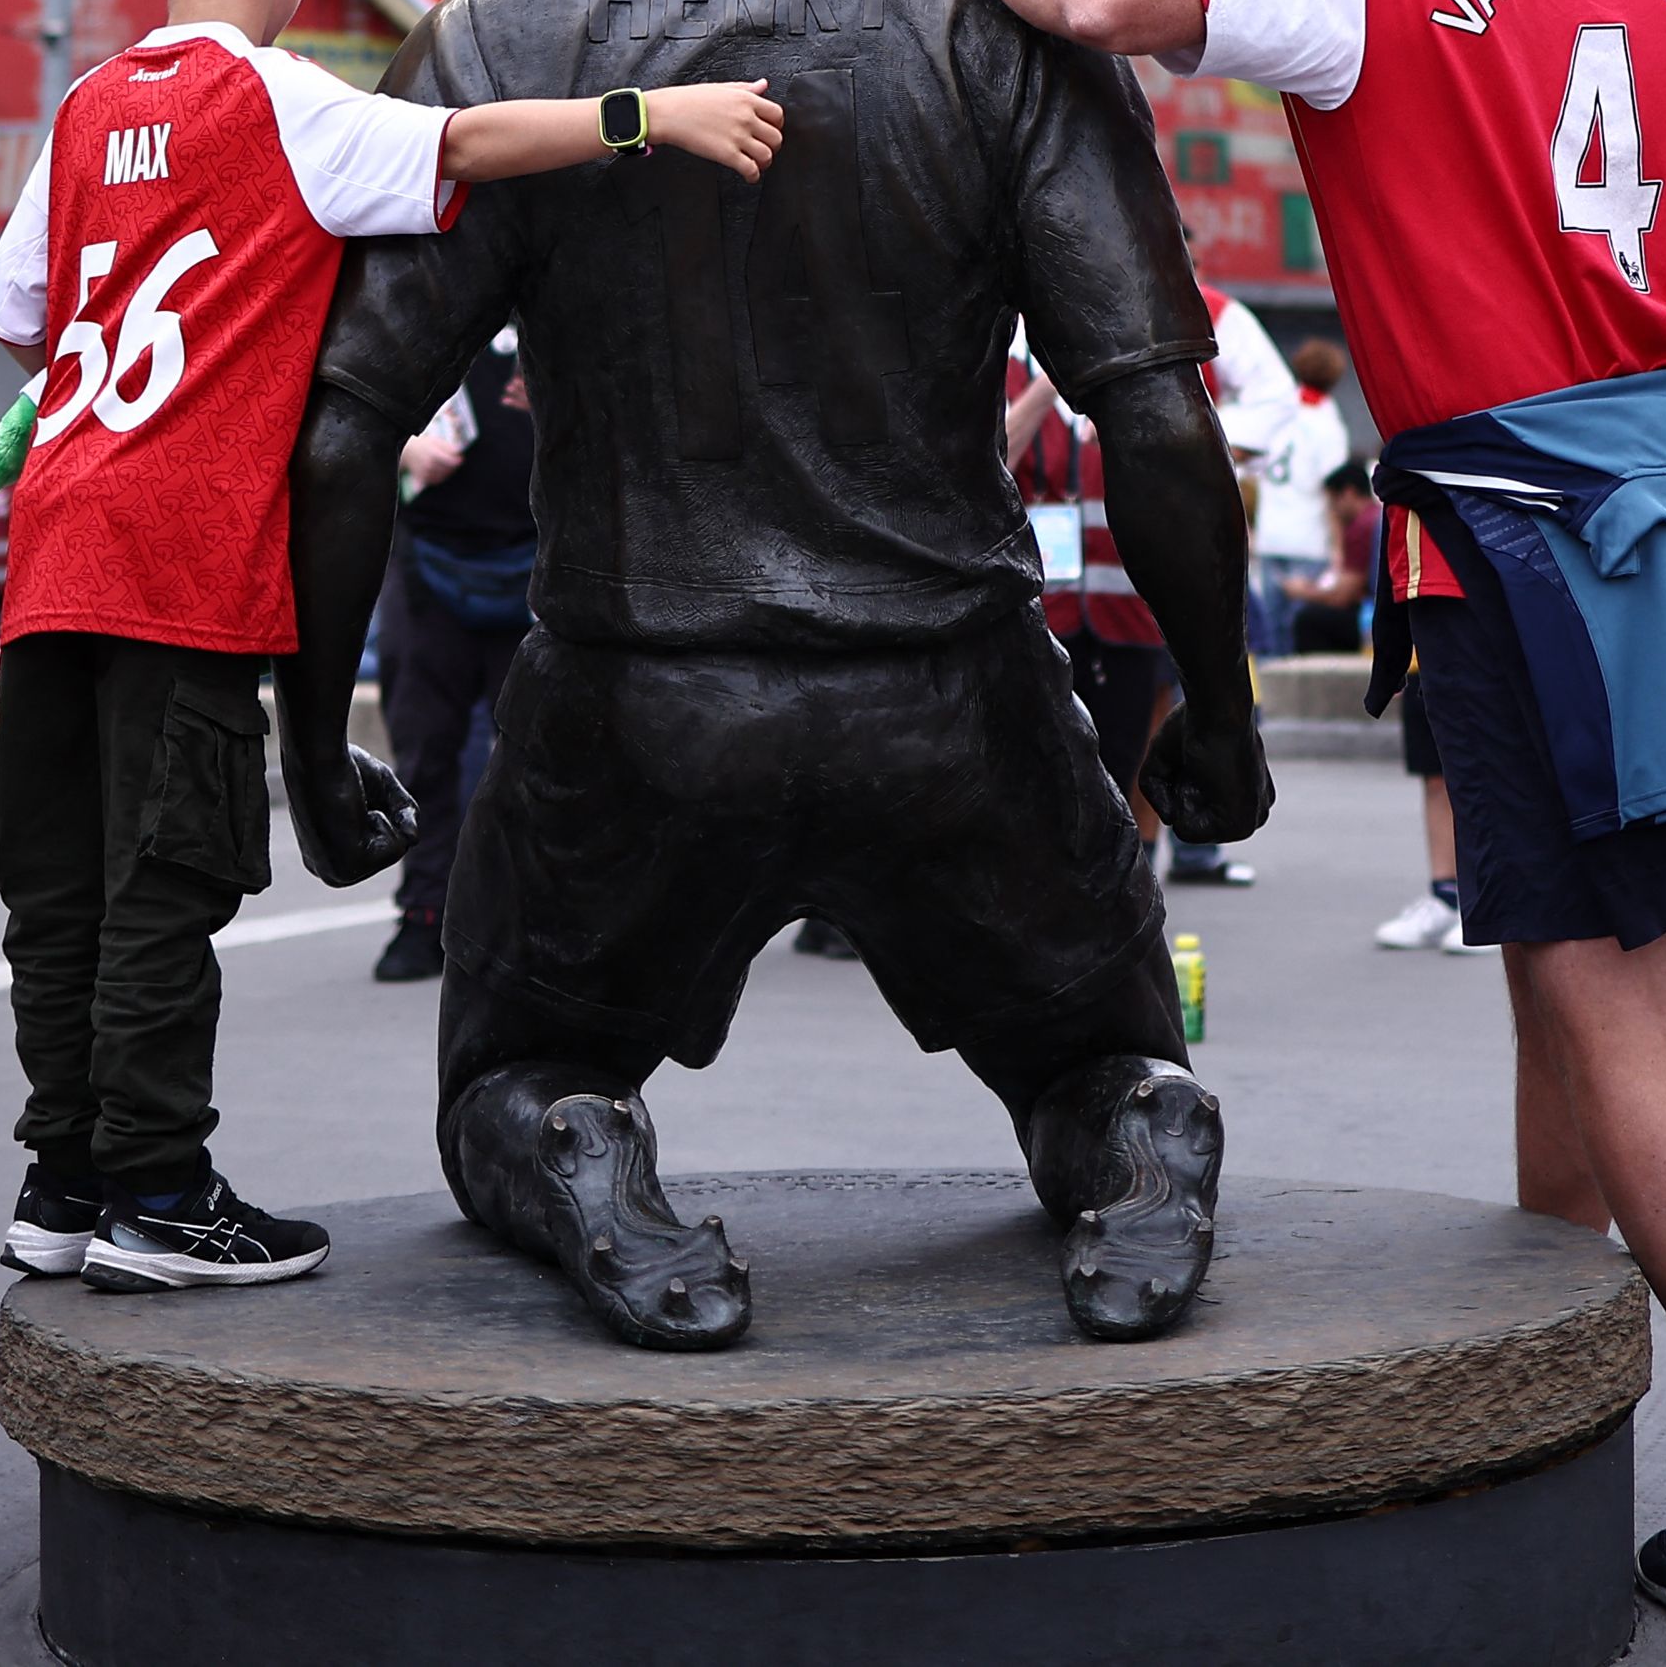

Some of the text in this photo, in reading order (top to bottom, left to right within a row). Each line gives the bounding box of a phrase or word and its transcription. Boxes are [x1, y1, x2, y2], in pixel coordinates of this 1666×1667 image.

[128, 59, 181, 83] Arsenal
[103, 122, 173, 187] MAX
[1550, 22, 1664, 294] 4
[31, 227, 221, 449] 56
